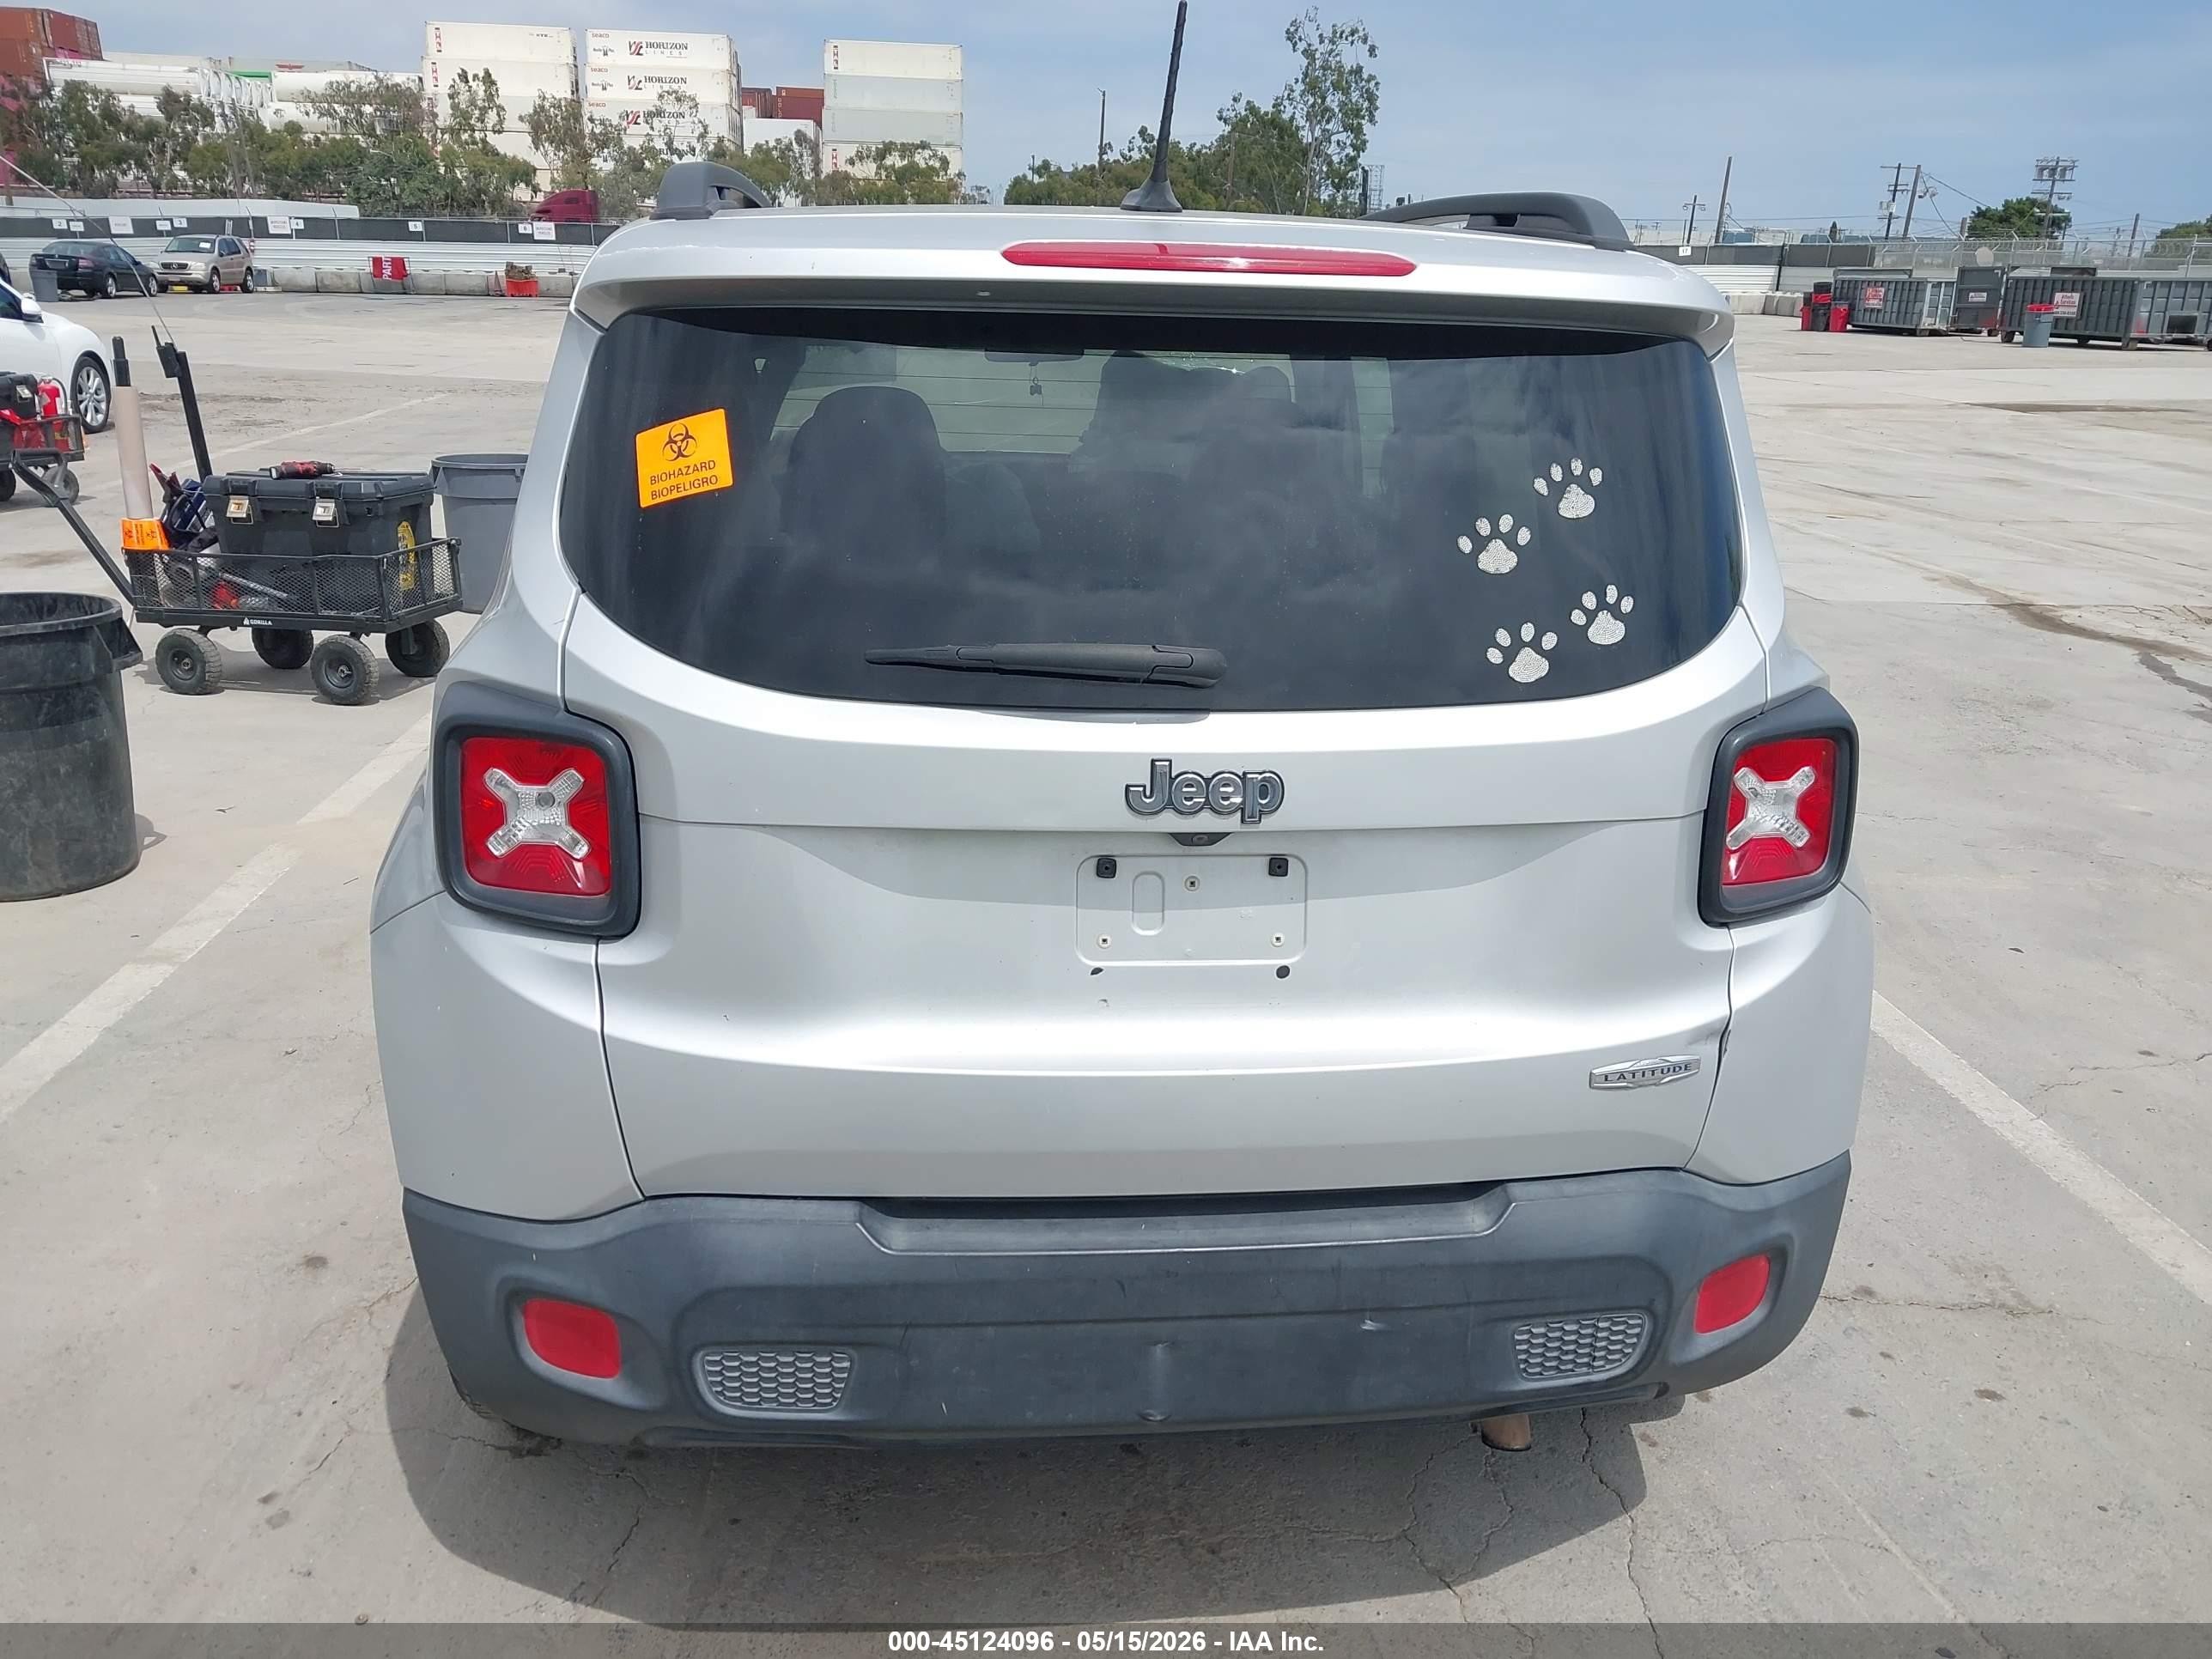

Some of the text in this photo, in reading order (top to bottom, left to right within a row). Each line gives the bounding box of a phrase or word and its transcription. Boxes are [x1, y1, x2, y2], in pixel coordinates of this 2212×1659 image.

[645, 41, 688, 50] HORIZON
[644, 76, 687, 84] HORIZON
[650, 459, 716, 486] BIOHAZARD
[651, 474, 719, 501] BIOPELIGRO
[1125, 758, 1285, 823] Jeep
[1604, 1063, 1692, 1082] LATITUDE
